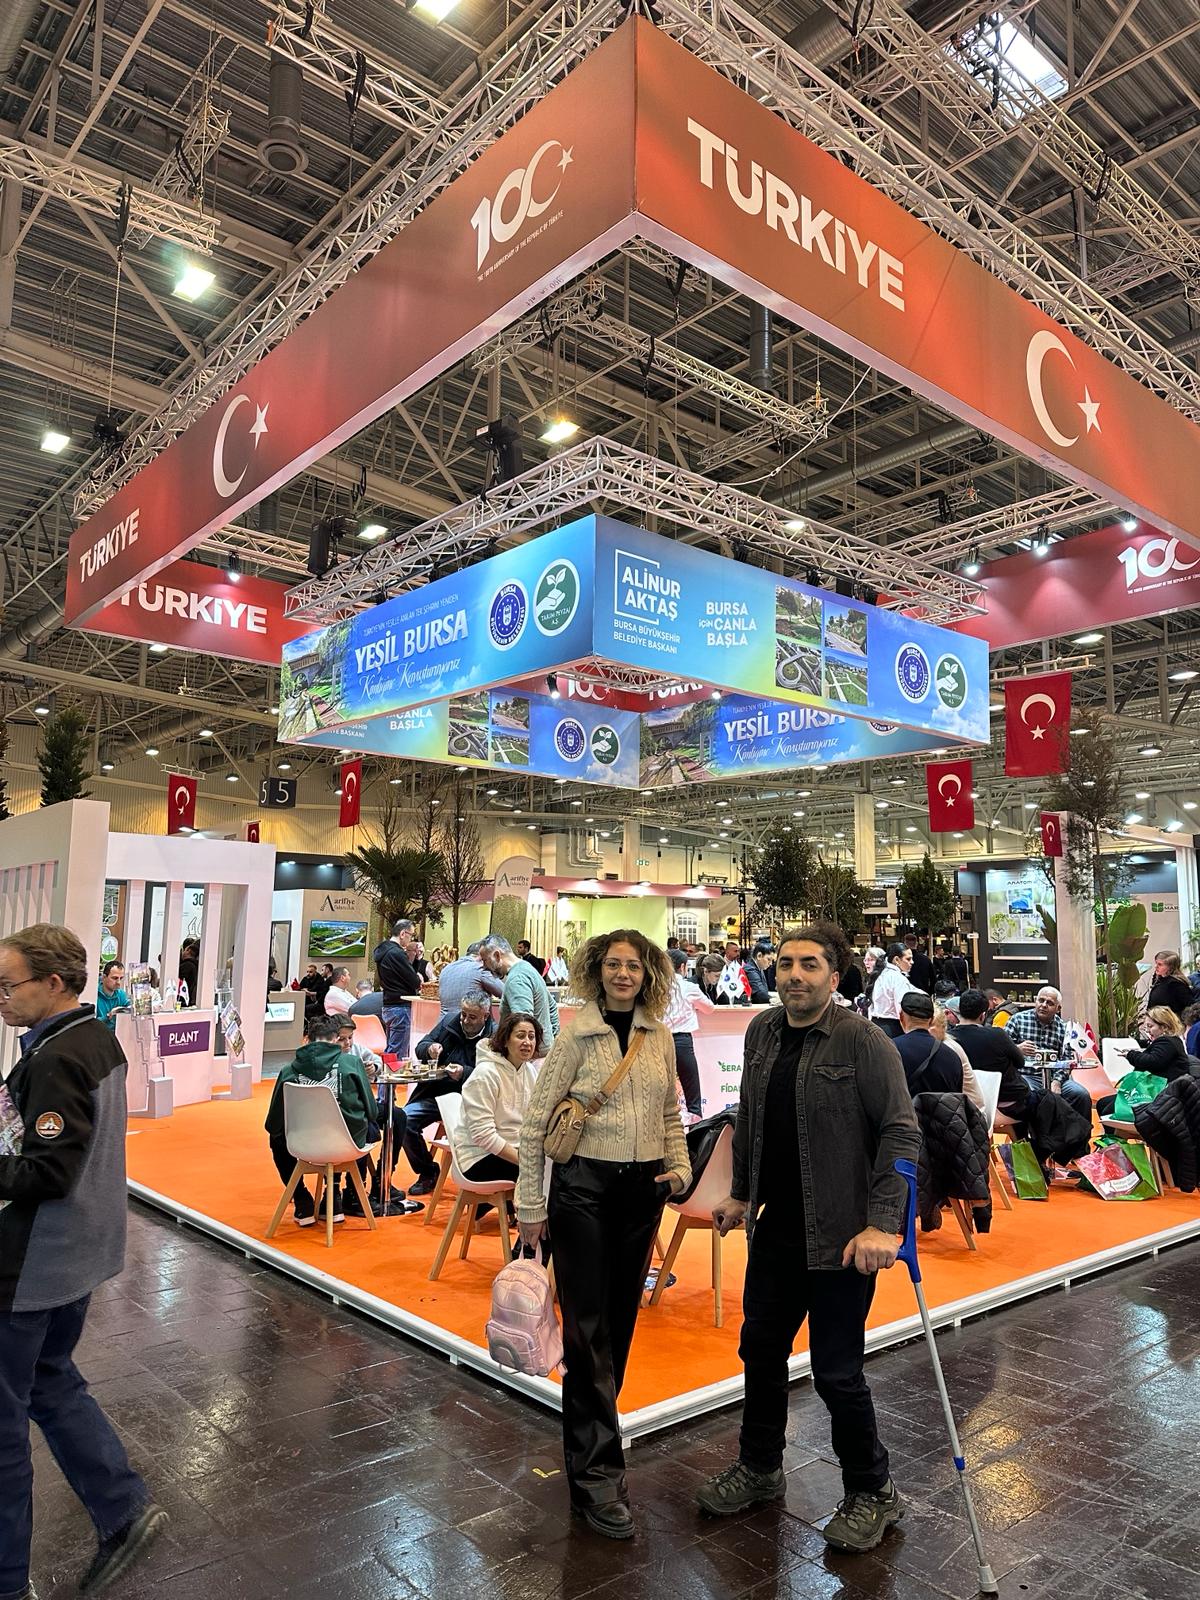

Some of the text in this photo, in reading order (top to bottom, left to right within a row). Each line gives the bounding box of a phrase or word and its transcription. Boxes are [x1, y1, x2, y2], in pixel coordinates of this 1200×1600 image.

[470, 140, 562, 272] 100
[687, 116, 905, 312] TÜRKİYE
[79, 508, 140, 584] TÜRKİYE
[500, 585, 516, 597] BURSA
[622, 566, 681, 599] ALİNUR
[624, 588, 678, 621] AKTAŞ
[706, 602, 749, 615] BURSA
[613, 618, 681, 644] BURSA BÜYÜKŞEHİR
[714, 618, 757, 631] CANLA
[355, 609, 469, 674] YEŞİL BURSA
[613, 631, 678, 654] BELEDİYE BAŞKANI
[706, 633, 748, 648] BAŞLA
[340, 729, 365, 738] BAŞKANI
[390, 720, 425, 731] BAŞLA
[724, 711, 773, 743] YEŞİL
[261, 781, 267, 803] 5
[275, 781, 289, 803] 5
[169, 1030, 199, 1045] PLANT
[721, 1064, 742, 1072] SERA
